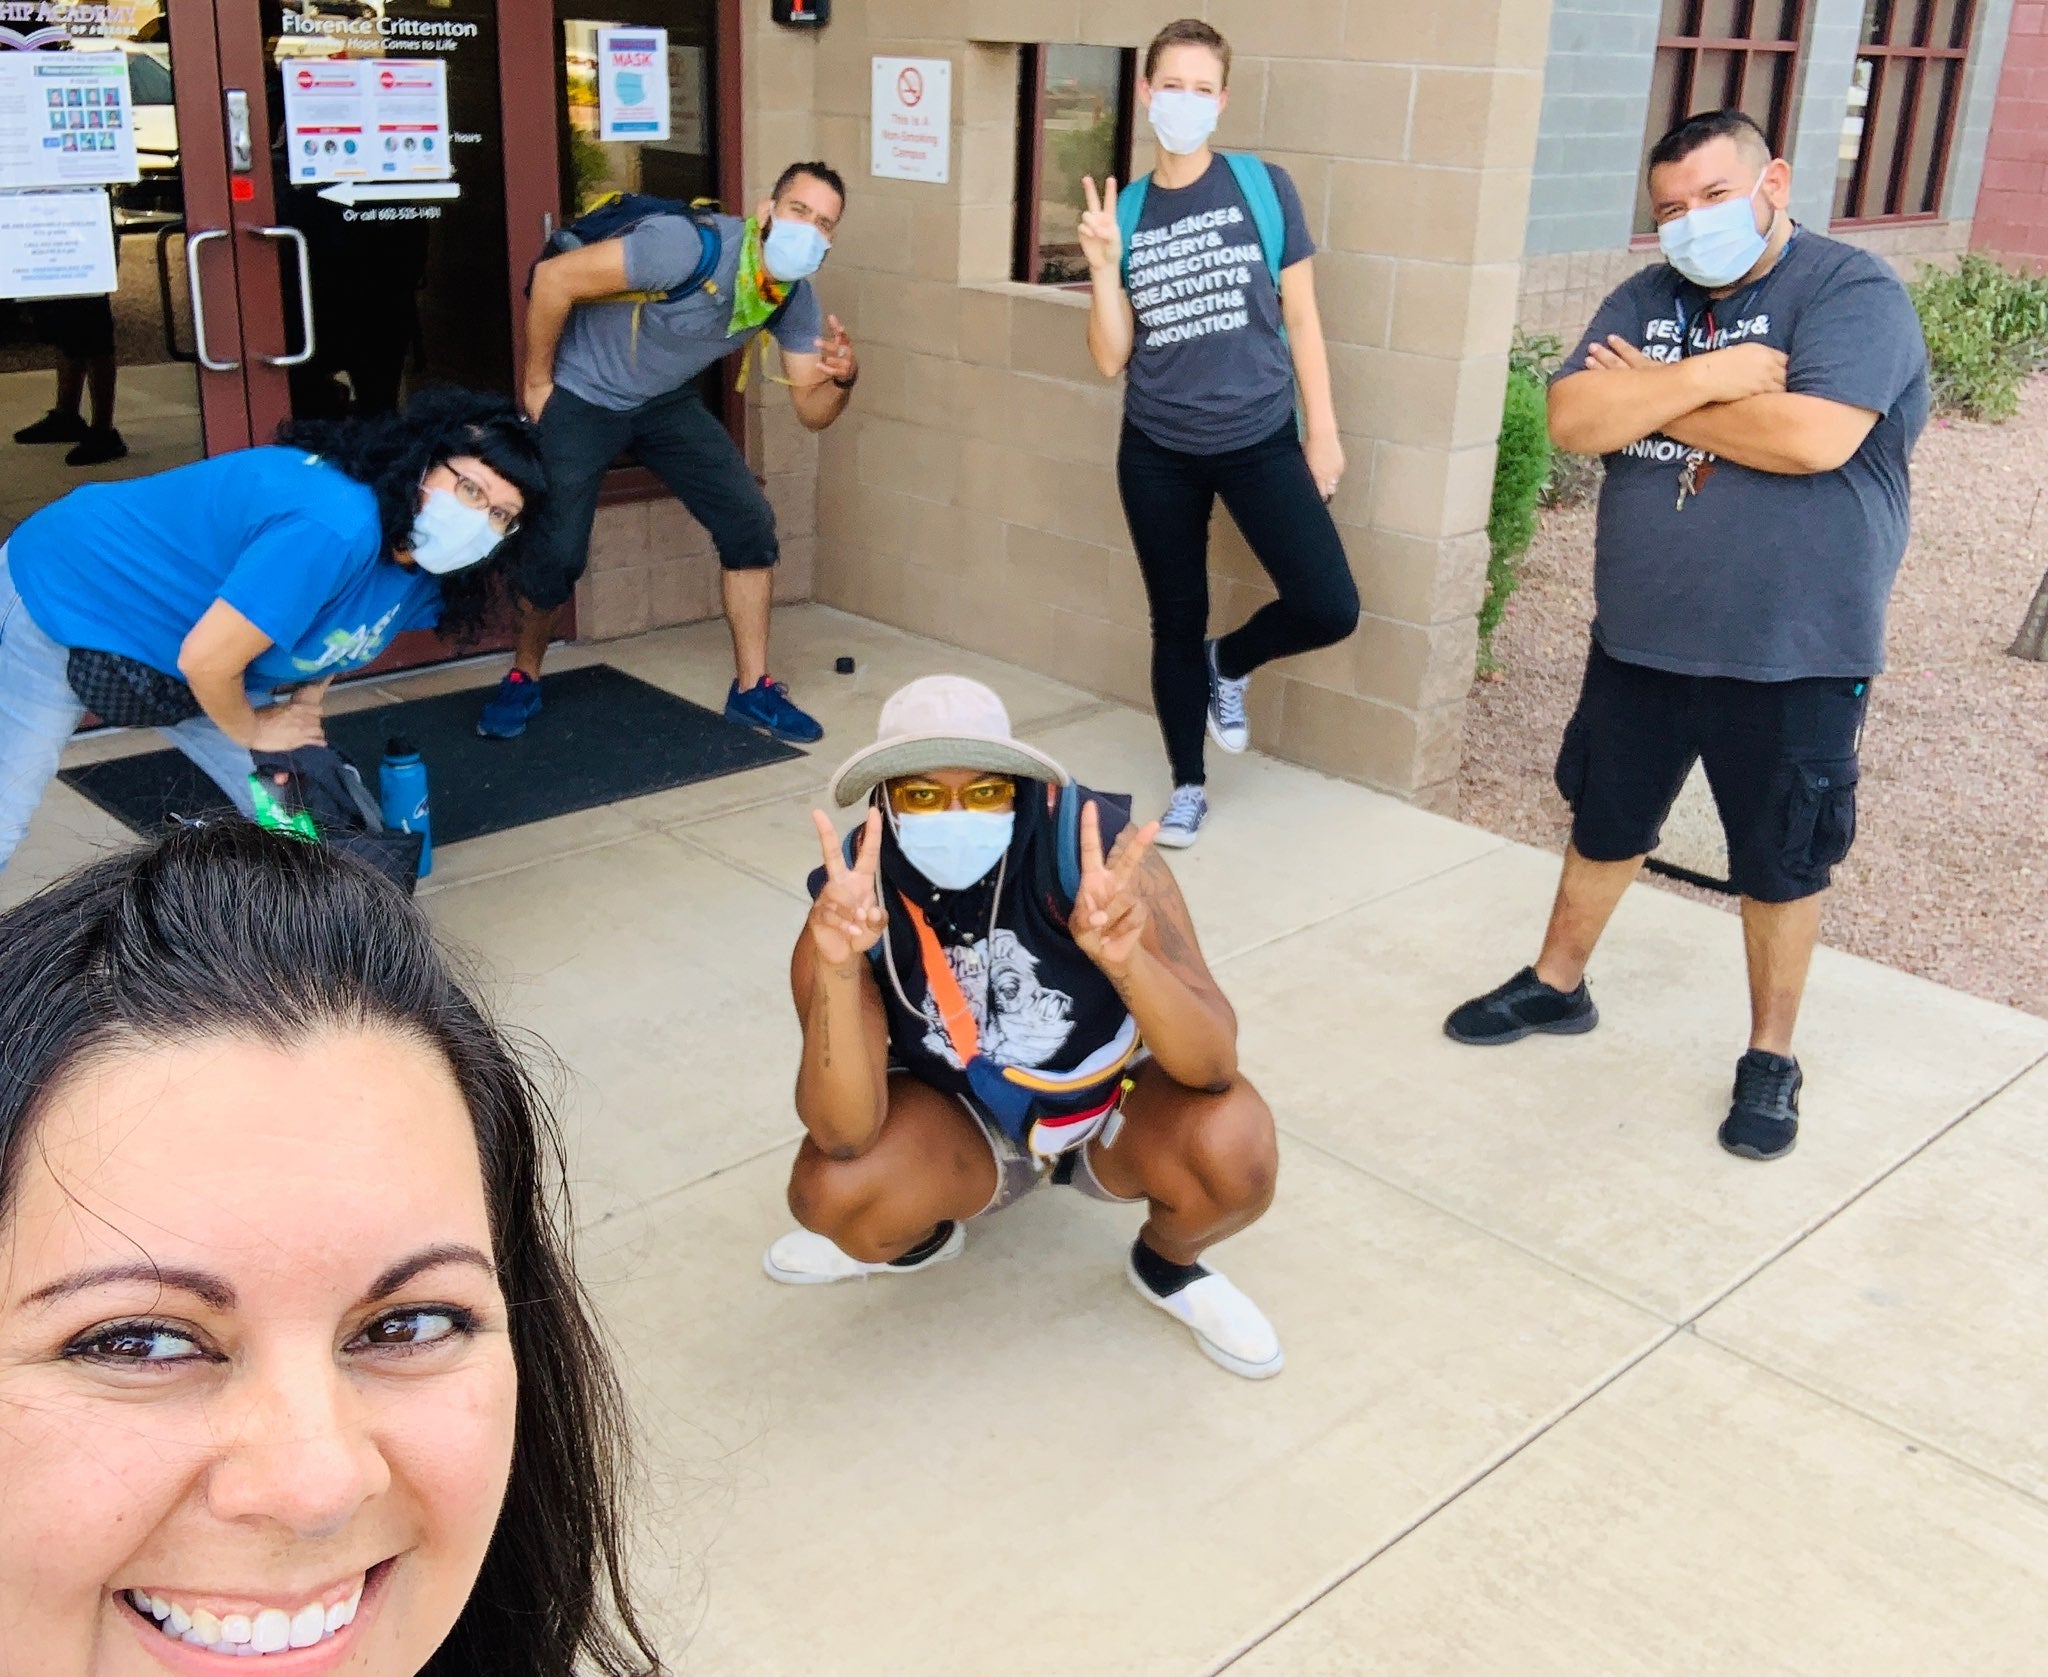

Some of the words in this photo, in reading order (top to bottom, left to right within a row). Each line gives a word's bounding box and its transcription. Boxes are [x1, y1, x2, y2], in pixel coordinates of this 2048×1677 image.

[36, 1, 136, 23] ACADEMY
[282, 14, 372, 35] Florence
[376, 17, 477, 37] Crittenton
[347, 38, 379, 50] Hope
[381, 38, 420, 50] Comes
[421, 40, 434, 50] to
[436, 38, 458, 51] Life
[613, 53, 653, 67] MASK
[881, 130, 939, 148] Non-Smoking
[343, 208, 359, 222] Or
[360, 208, 377, 221] call
[1130, 205, 1244, 250] ESILIENCE&
